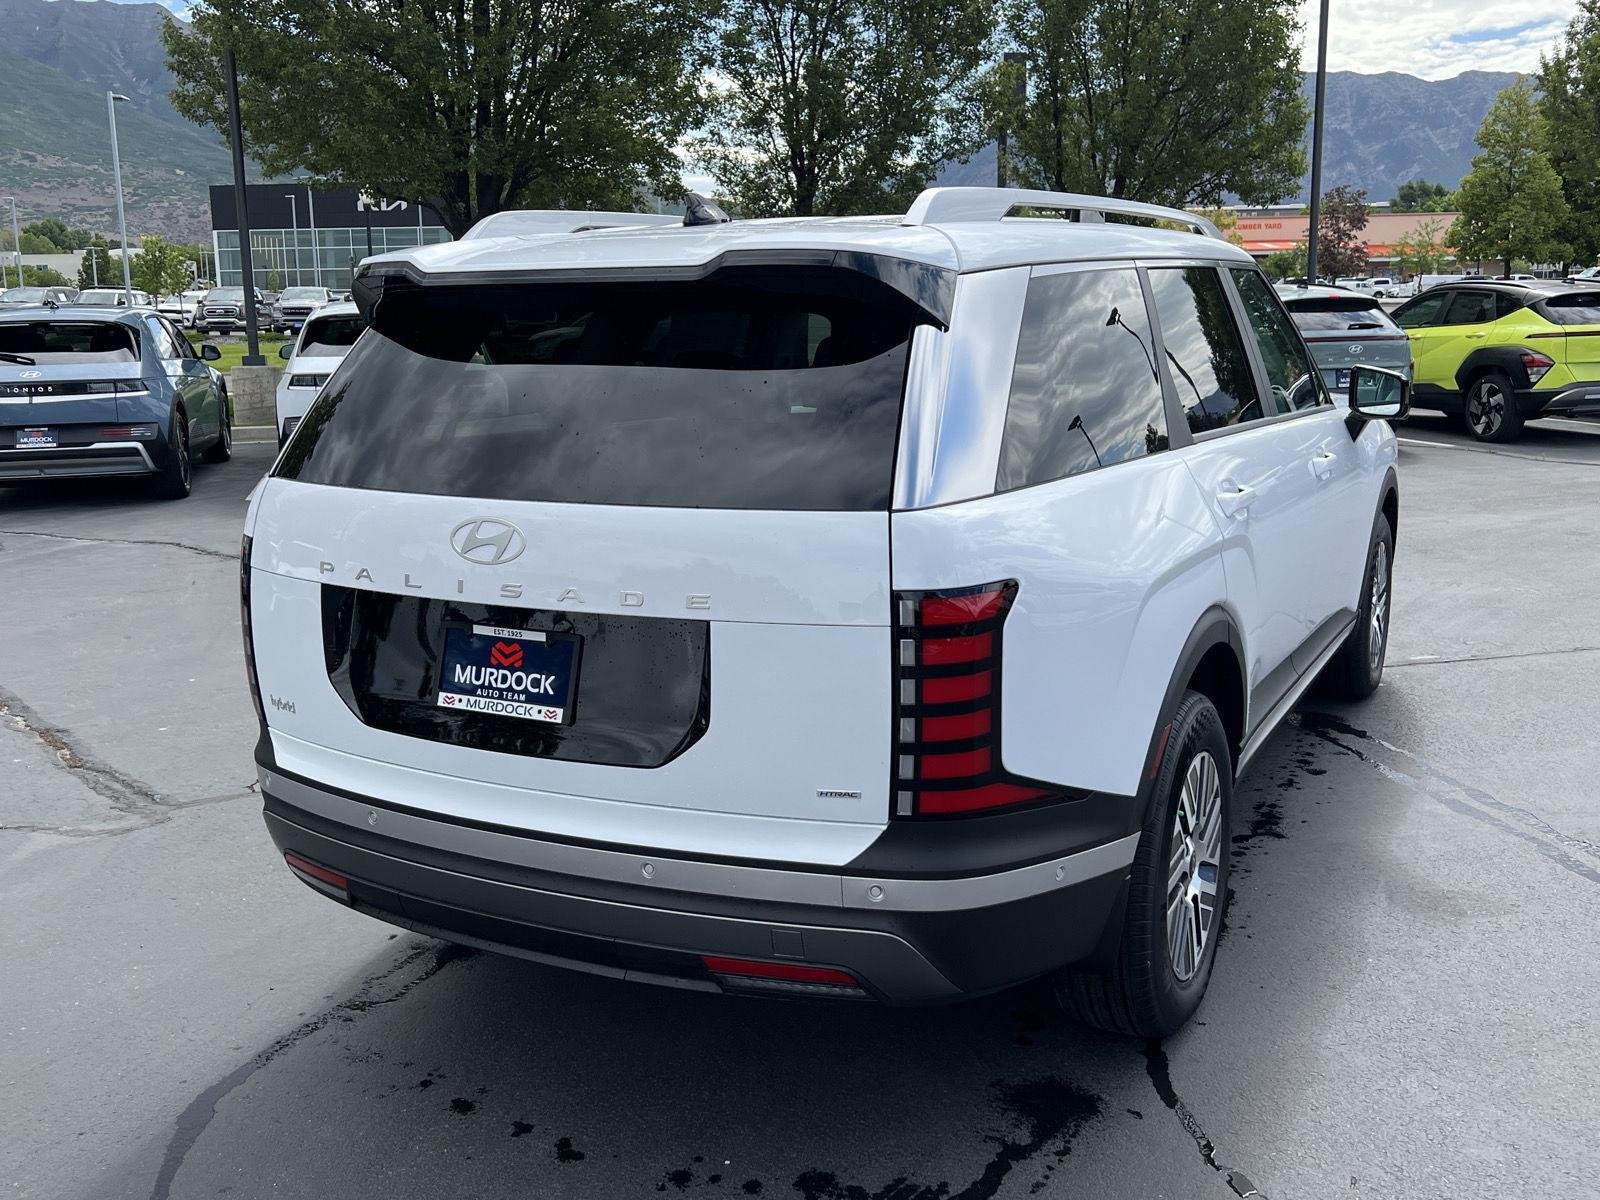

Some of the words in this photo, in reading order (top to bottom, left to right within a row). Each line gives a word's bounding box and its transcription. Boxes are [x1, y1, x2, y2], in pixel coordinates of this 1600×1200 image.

[1264, 222, 1282, 230] YARD
[319, 560, 712, 610] PALISADE
[493, 628, 506, 637] EST.
[507, 629, 523, 638] 1925
[454, 663, 556, 695] MURDOCK
[476, 688, 500, 698] AUTO
[502, 690, 526, 701] TEAM
[465, 697, 534, 717] MURDOCK
[819, 790, 859, 799] HTRAC
